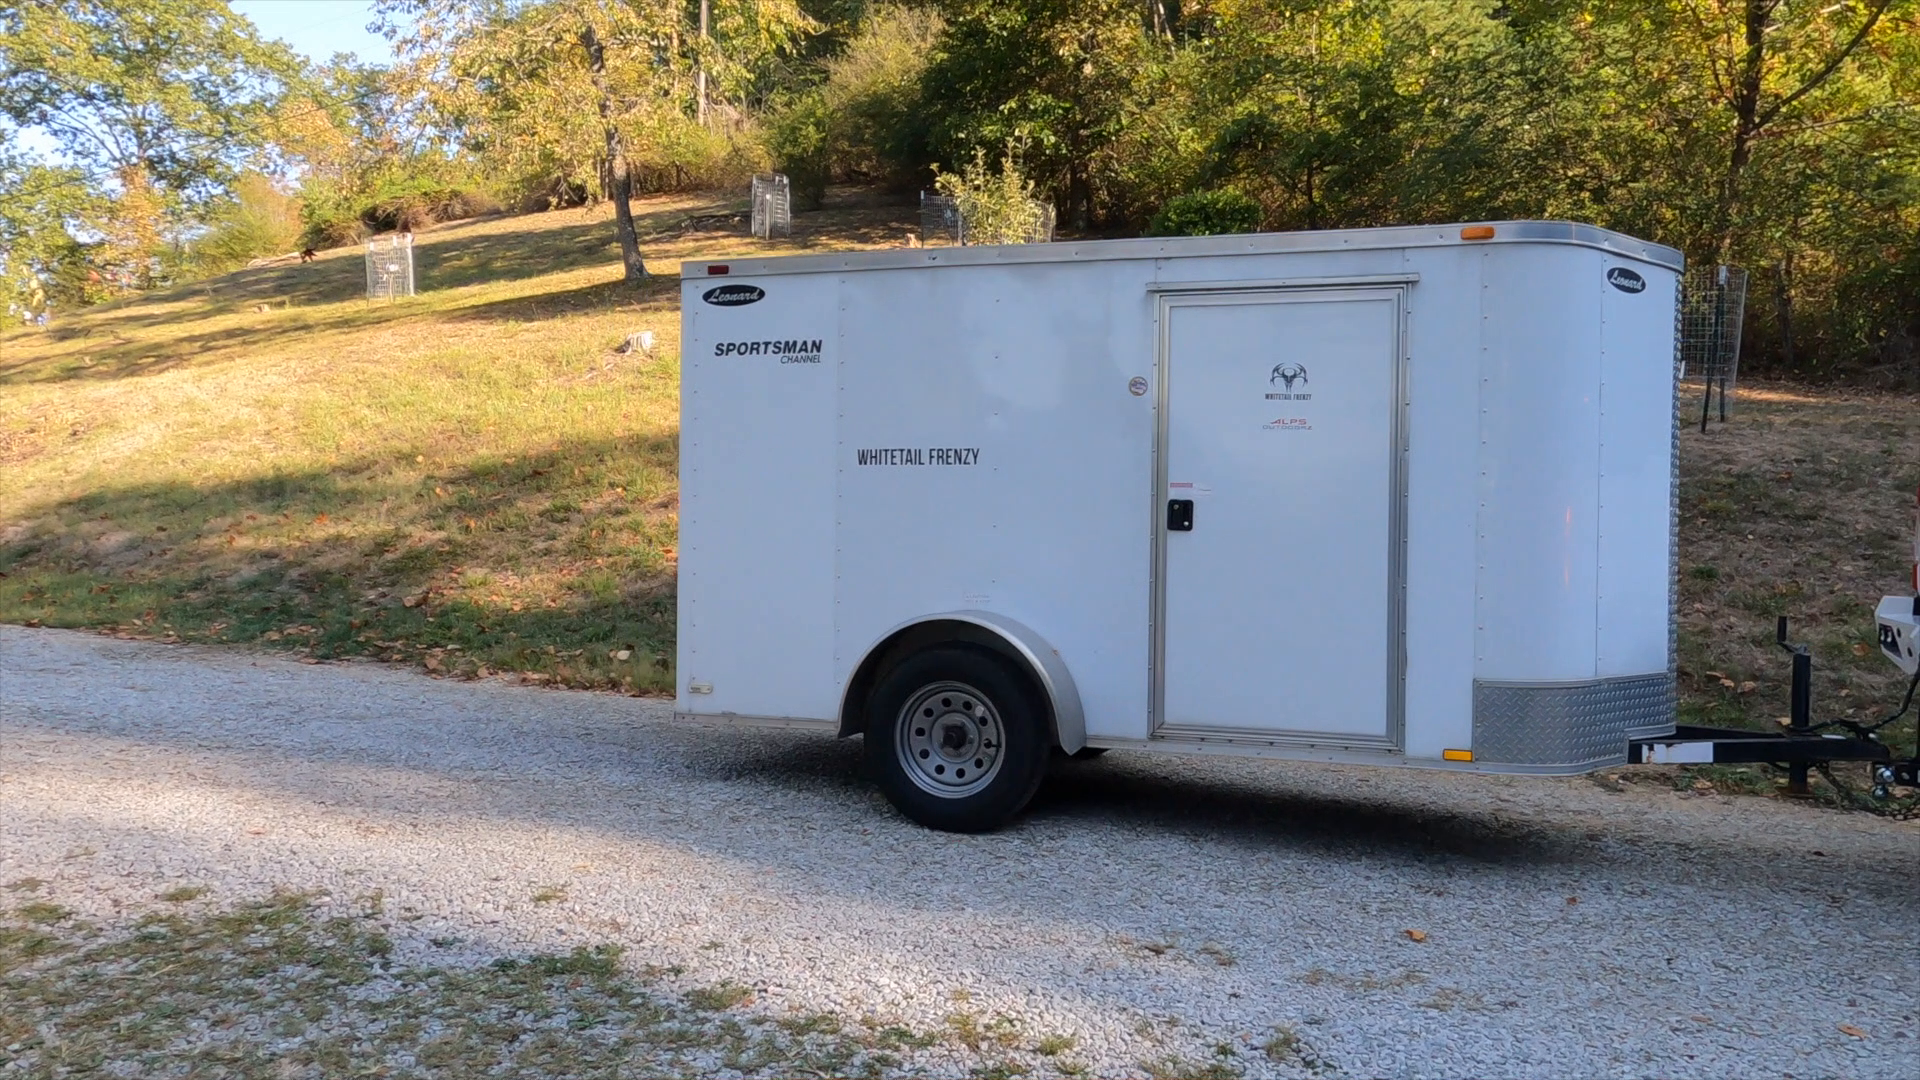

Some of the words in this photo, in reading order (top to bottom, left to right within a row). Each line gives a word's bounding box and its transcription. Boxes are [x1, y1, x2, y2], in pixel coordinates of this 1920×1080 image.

[1610, 269, 1643, 290] Leonard
[707, 288, 760, 302] Leonard
[714, 340, 822, 356] SPORTSMAN
[780, 354, 821, 364] CHANNEL
[857, 448, 925, 465] WHITETAIL
[929, 448, 980, 465] FRENZY
